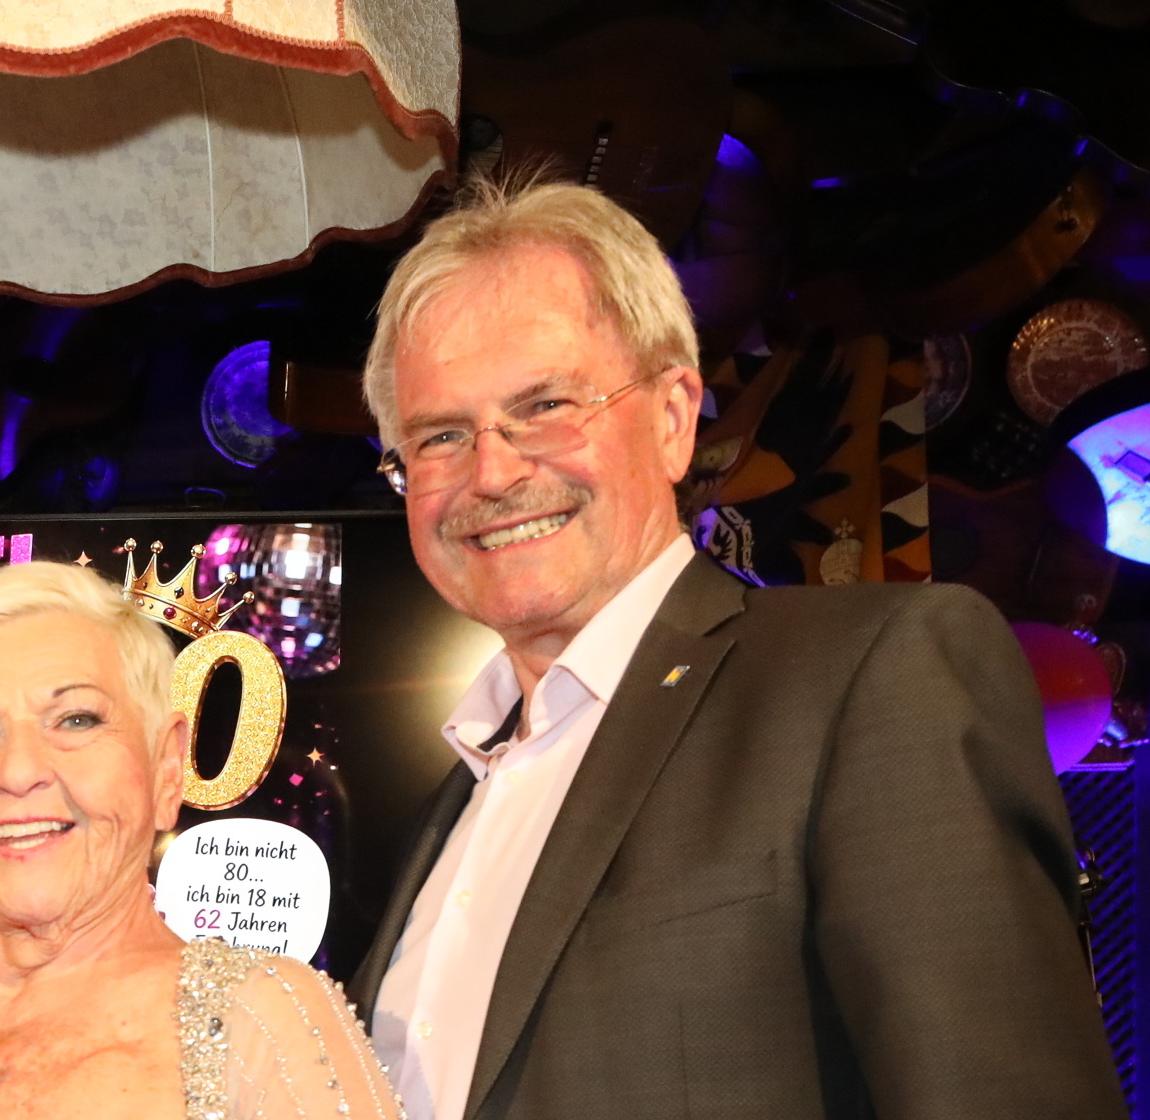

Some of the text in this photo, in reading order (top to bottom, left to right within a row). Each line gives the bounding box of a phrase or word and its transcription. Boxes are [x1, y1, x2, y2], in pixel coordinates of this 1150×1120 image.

[195, 836, 298, 860] Ich bin nicht
[224, 862, 264, 883] 80...
[186, 885, 301, 909] ich bin 18 mit
[194, 908, 288, 933] 62 Jahren
